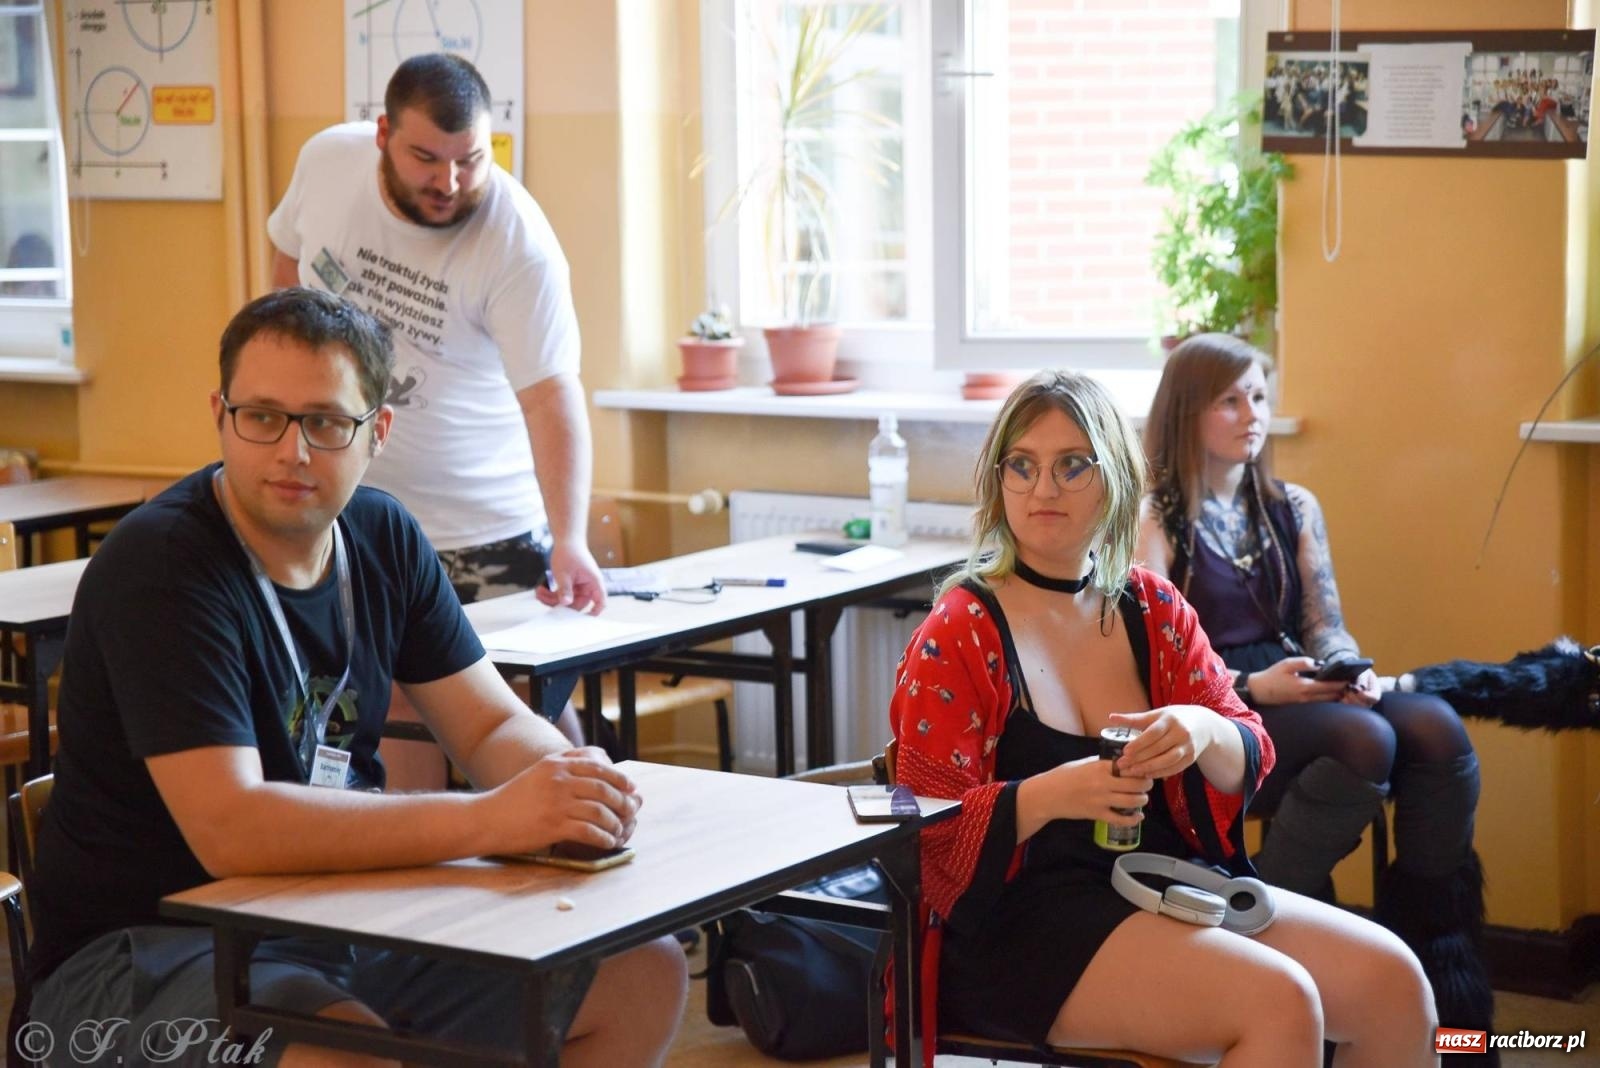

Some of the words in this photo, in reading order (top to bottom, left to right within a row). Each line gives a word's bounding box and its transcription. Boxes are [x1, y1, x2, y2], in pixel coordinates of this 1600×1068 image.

[356, 247, 378, 264] Nie
[379, 255, 420, 284] traktuj
[418, 270, 449, 294] życia
[361, 268, 386, 286] zbyt
[386, 281, 448, 312] poważnie.
[347, 280, 364, 295] ak
[367, 287, 384, 303] nie
[385, 298, 444, 329] wyjdziesz
